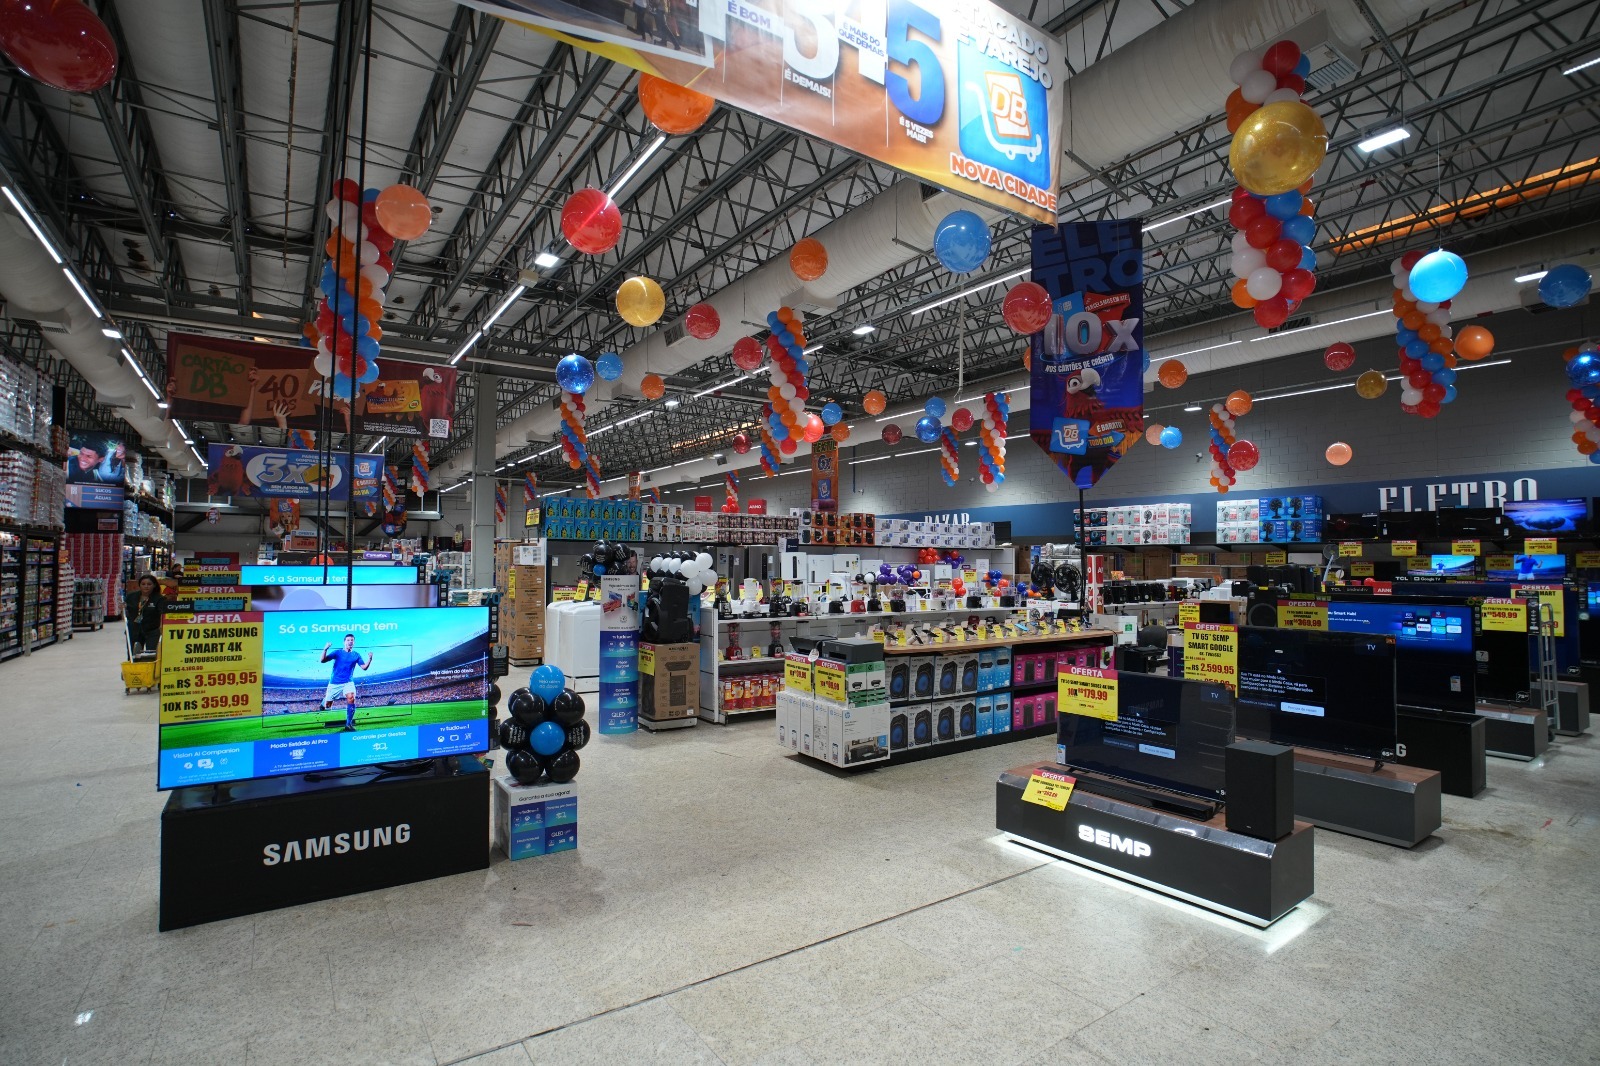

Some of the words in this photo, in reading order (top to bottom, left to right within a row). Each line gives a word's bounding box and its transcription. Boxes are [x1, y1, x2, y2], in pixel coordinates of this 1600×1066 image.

[740, 8, 771, 29] BOM
[838, 28, 855, 43] QUE
[855, 37, 885, 58] DEMAIS
[850, 26, 869, 41] MAIS
[869, 35, 881, 47] DO
[886, 0, 945, 125] 5
[970, 34, 1053, 90] VAREJO
[784, 68, 792, 81] É
[792, 74, 832, 98] DEMAIS!
[990, 83, 1028, 127] DB
[910, 121, 934, 139] VEZES
[951, 154, 1001, 189] NOVA
[1003, 174, 1057, 211] CIDADE
[181, 353, 245, 375] CARTÃO
[1045, 364, 1056, 373] NOS
[1058, 362, 1082, 372] CARTÕES
[1083, 360, 1090, 368] DE
[1092, 353, 1114, 366] CRÉDITO
[191, 372, 228, 398] DB
[258, 374, 298, 396] 40
[264, 575, 275, 583] Só
[287, 575, 329, 584] Samsung
[197, 586, 236, 594] OFERTA
[187, 614, 242, 623] OFERTA
[279, 623, 295, 634] Só
[299, 625, 308, 633] a
[311, 622, 370, 634] Samsung
[373, 621, 398, 631] tem
[169, 629, 185, 640] TV
[187, 629, 200, 639] 70
[203, 627, 258, 639] SAMSUNG
[1196, 624, 1224, 632] OFERT
[1188, 642, 1209, 650] SMART
[1209, 643, 1234, 652] GOOGLE
[1212, 634, 1230, 642] SEMP
[185, 642, 226, 654] SMART
[227, 642, 242, 652] 4K
[821, 661, 839, 670] OFERTA
[1071, 667, 1103, 678] OFERTA
[1200, 663, 1234, 675] 2.599,95
[177, 679, 191, 688] R$
[194, 672, 258, 687] 3.599,95
[163, 701, 182, 712] 10X
[184, 700, 198, 710] R$
[201, 694, 249, 709] 359,99
[173, 751, 193, 759] Vision
[202, 747, 240, 757] Companion
[1042, 772, 1065, 782] OFERTA
[263, 823, 411, 866] SAMSUNG
[1078, 824, 1152, 858] SEMP
